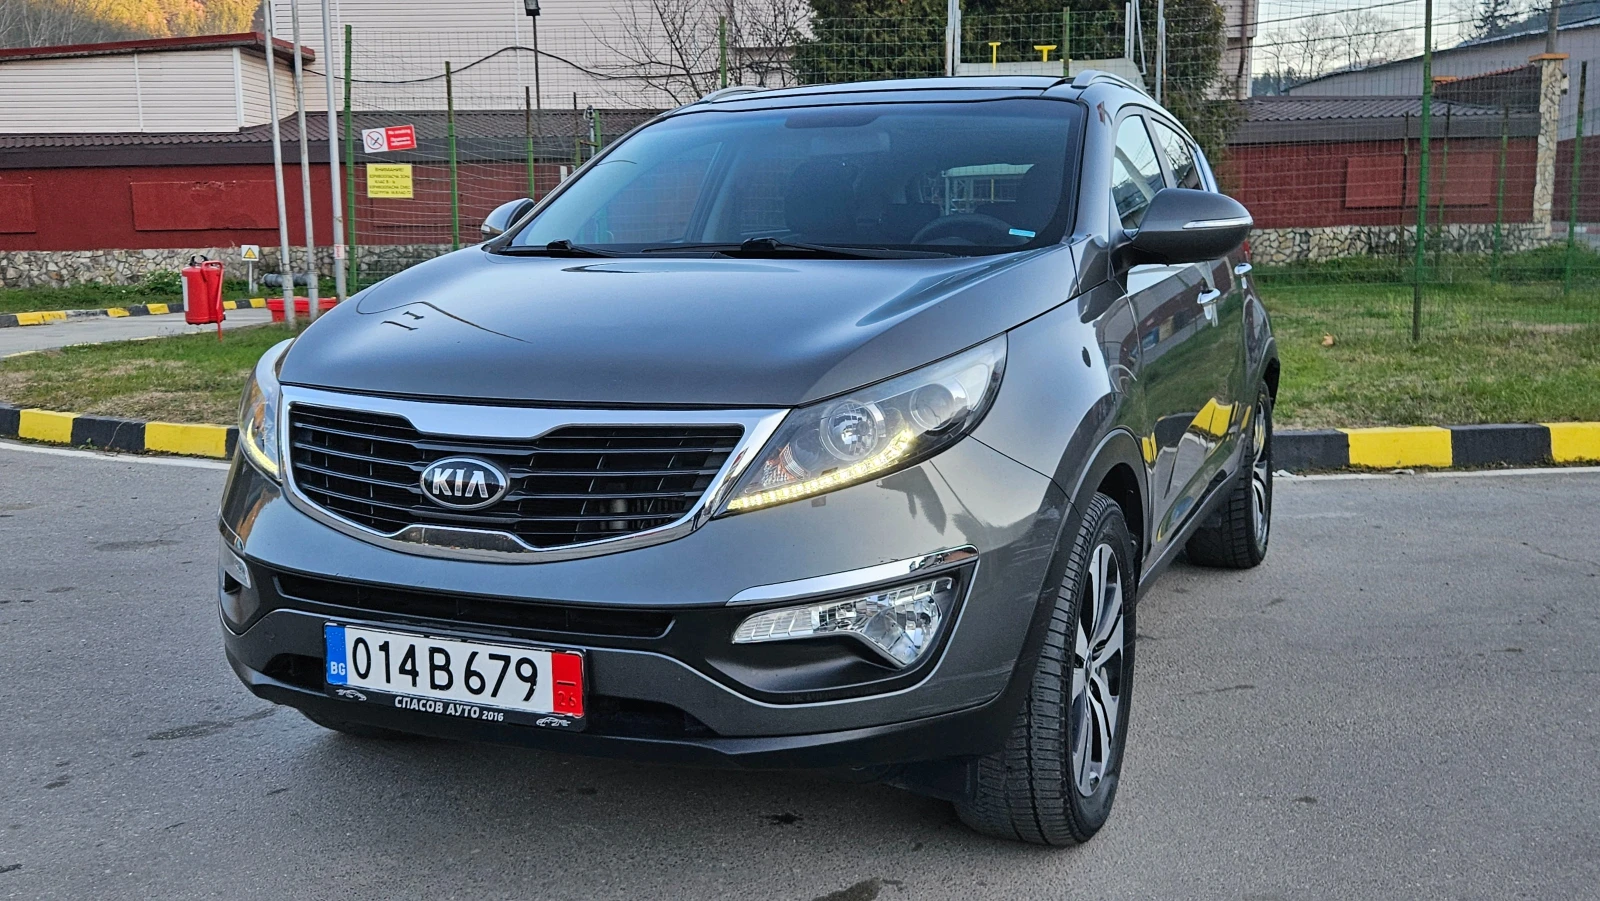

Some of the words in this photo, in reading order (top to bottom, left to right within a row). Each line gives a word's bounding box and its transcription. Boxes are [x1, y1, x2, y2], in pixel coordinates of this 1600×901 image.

[432, 468, 488, 498] KIA
[330, 661, 346, 676] BG
[394, 696, 444, 715] СПАСОВ
[446, 703, 480, 719] АУТО
[482, 710, 504, 722] 2016
